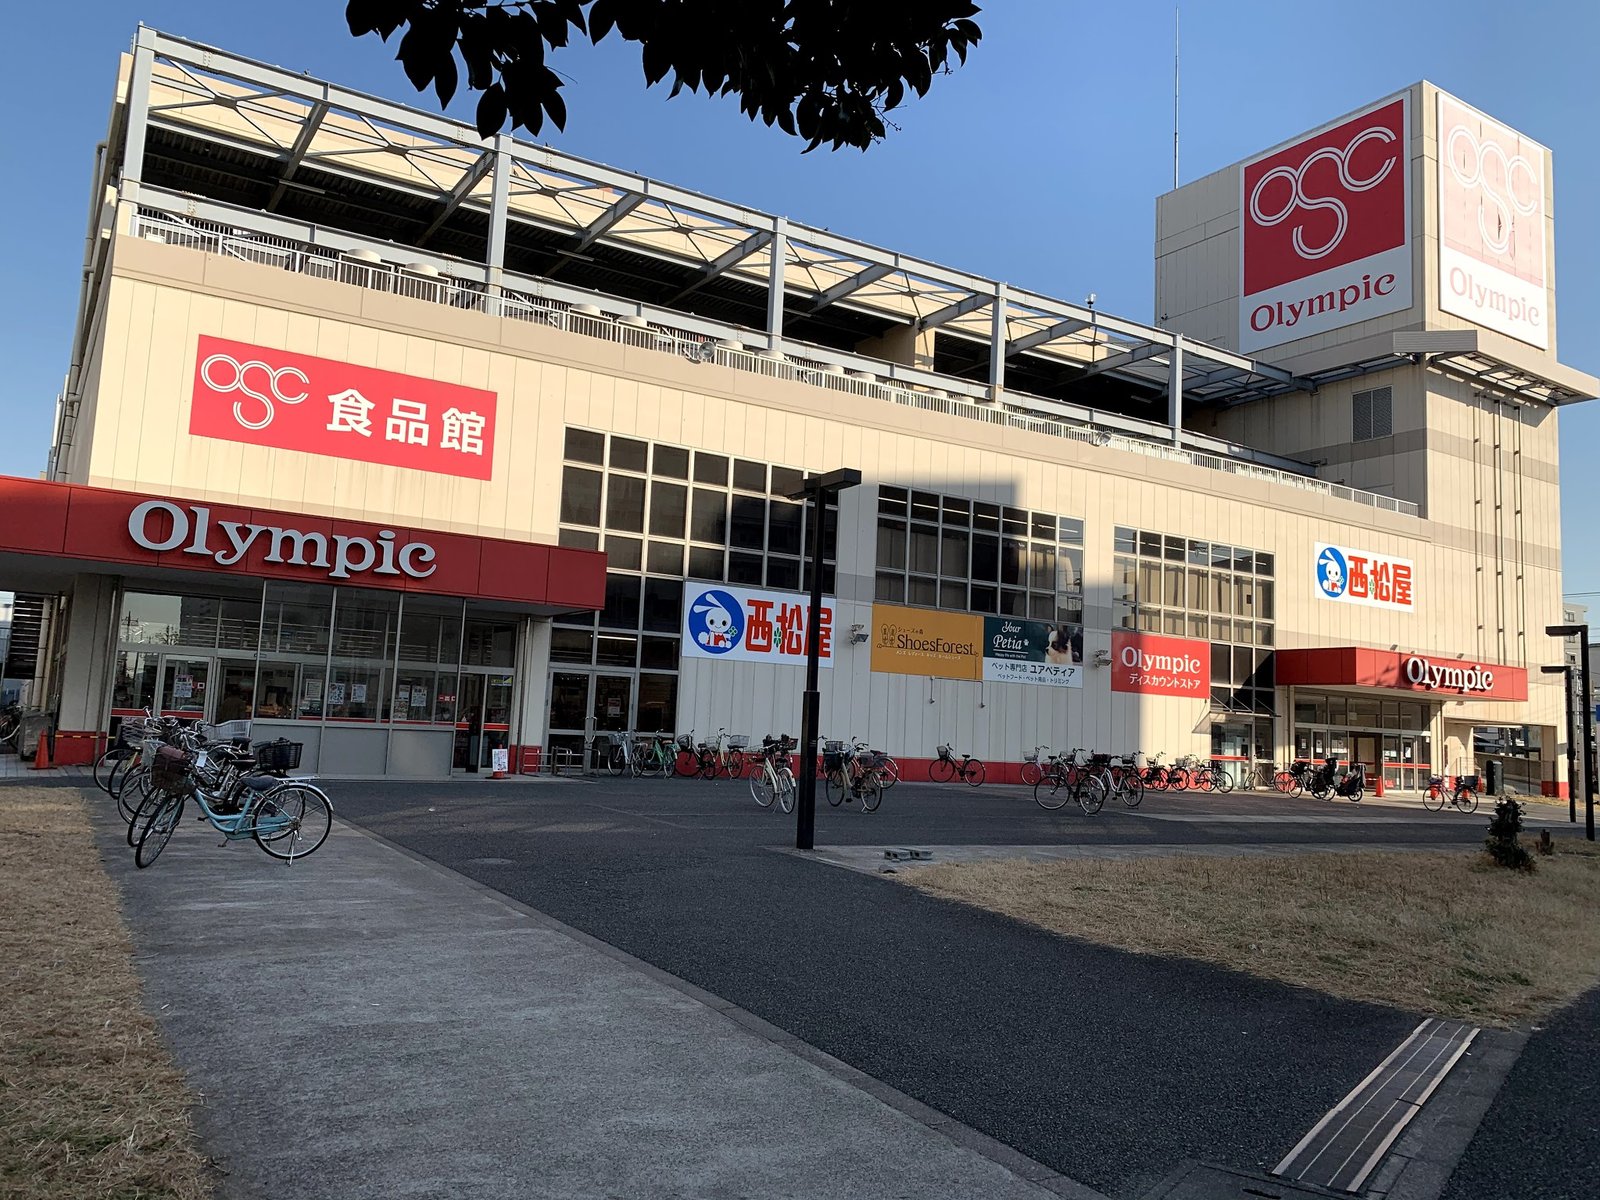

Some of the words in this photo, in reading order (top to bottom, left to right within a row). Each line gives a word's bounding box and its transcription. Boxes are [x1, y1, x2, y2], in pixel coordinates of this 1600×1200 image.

[1250, 273, 1396, 332] Olympic
[1450, 266, 1540, 327] Olympic
[326, 388, 486, 456] 食品館
[127, 500, 437, 579] Olympic
[1348, 555, 1412, 605] 西松屋
[745, 599, 832, 658] 西松屋
[897, 634, 974, 655] ShoesForest
[993, 634, 1022, 650] Petia
[1001, 621, 1021, 633] Your
[991, 662, 1027, 672] ペット専門店
[1121, 646, 1200, 674] Olympic
[1407, 657, 1494, 692] Olympic
[1129, 673, 1200, 690] ディスカウントストア
